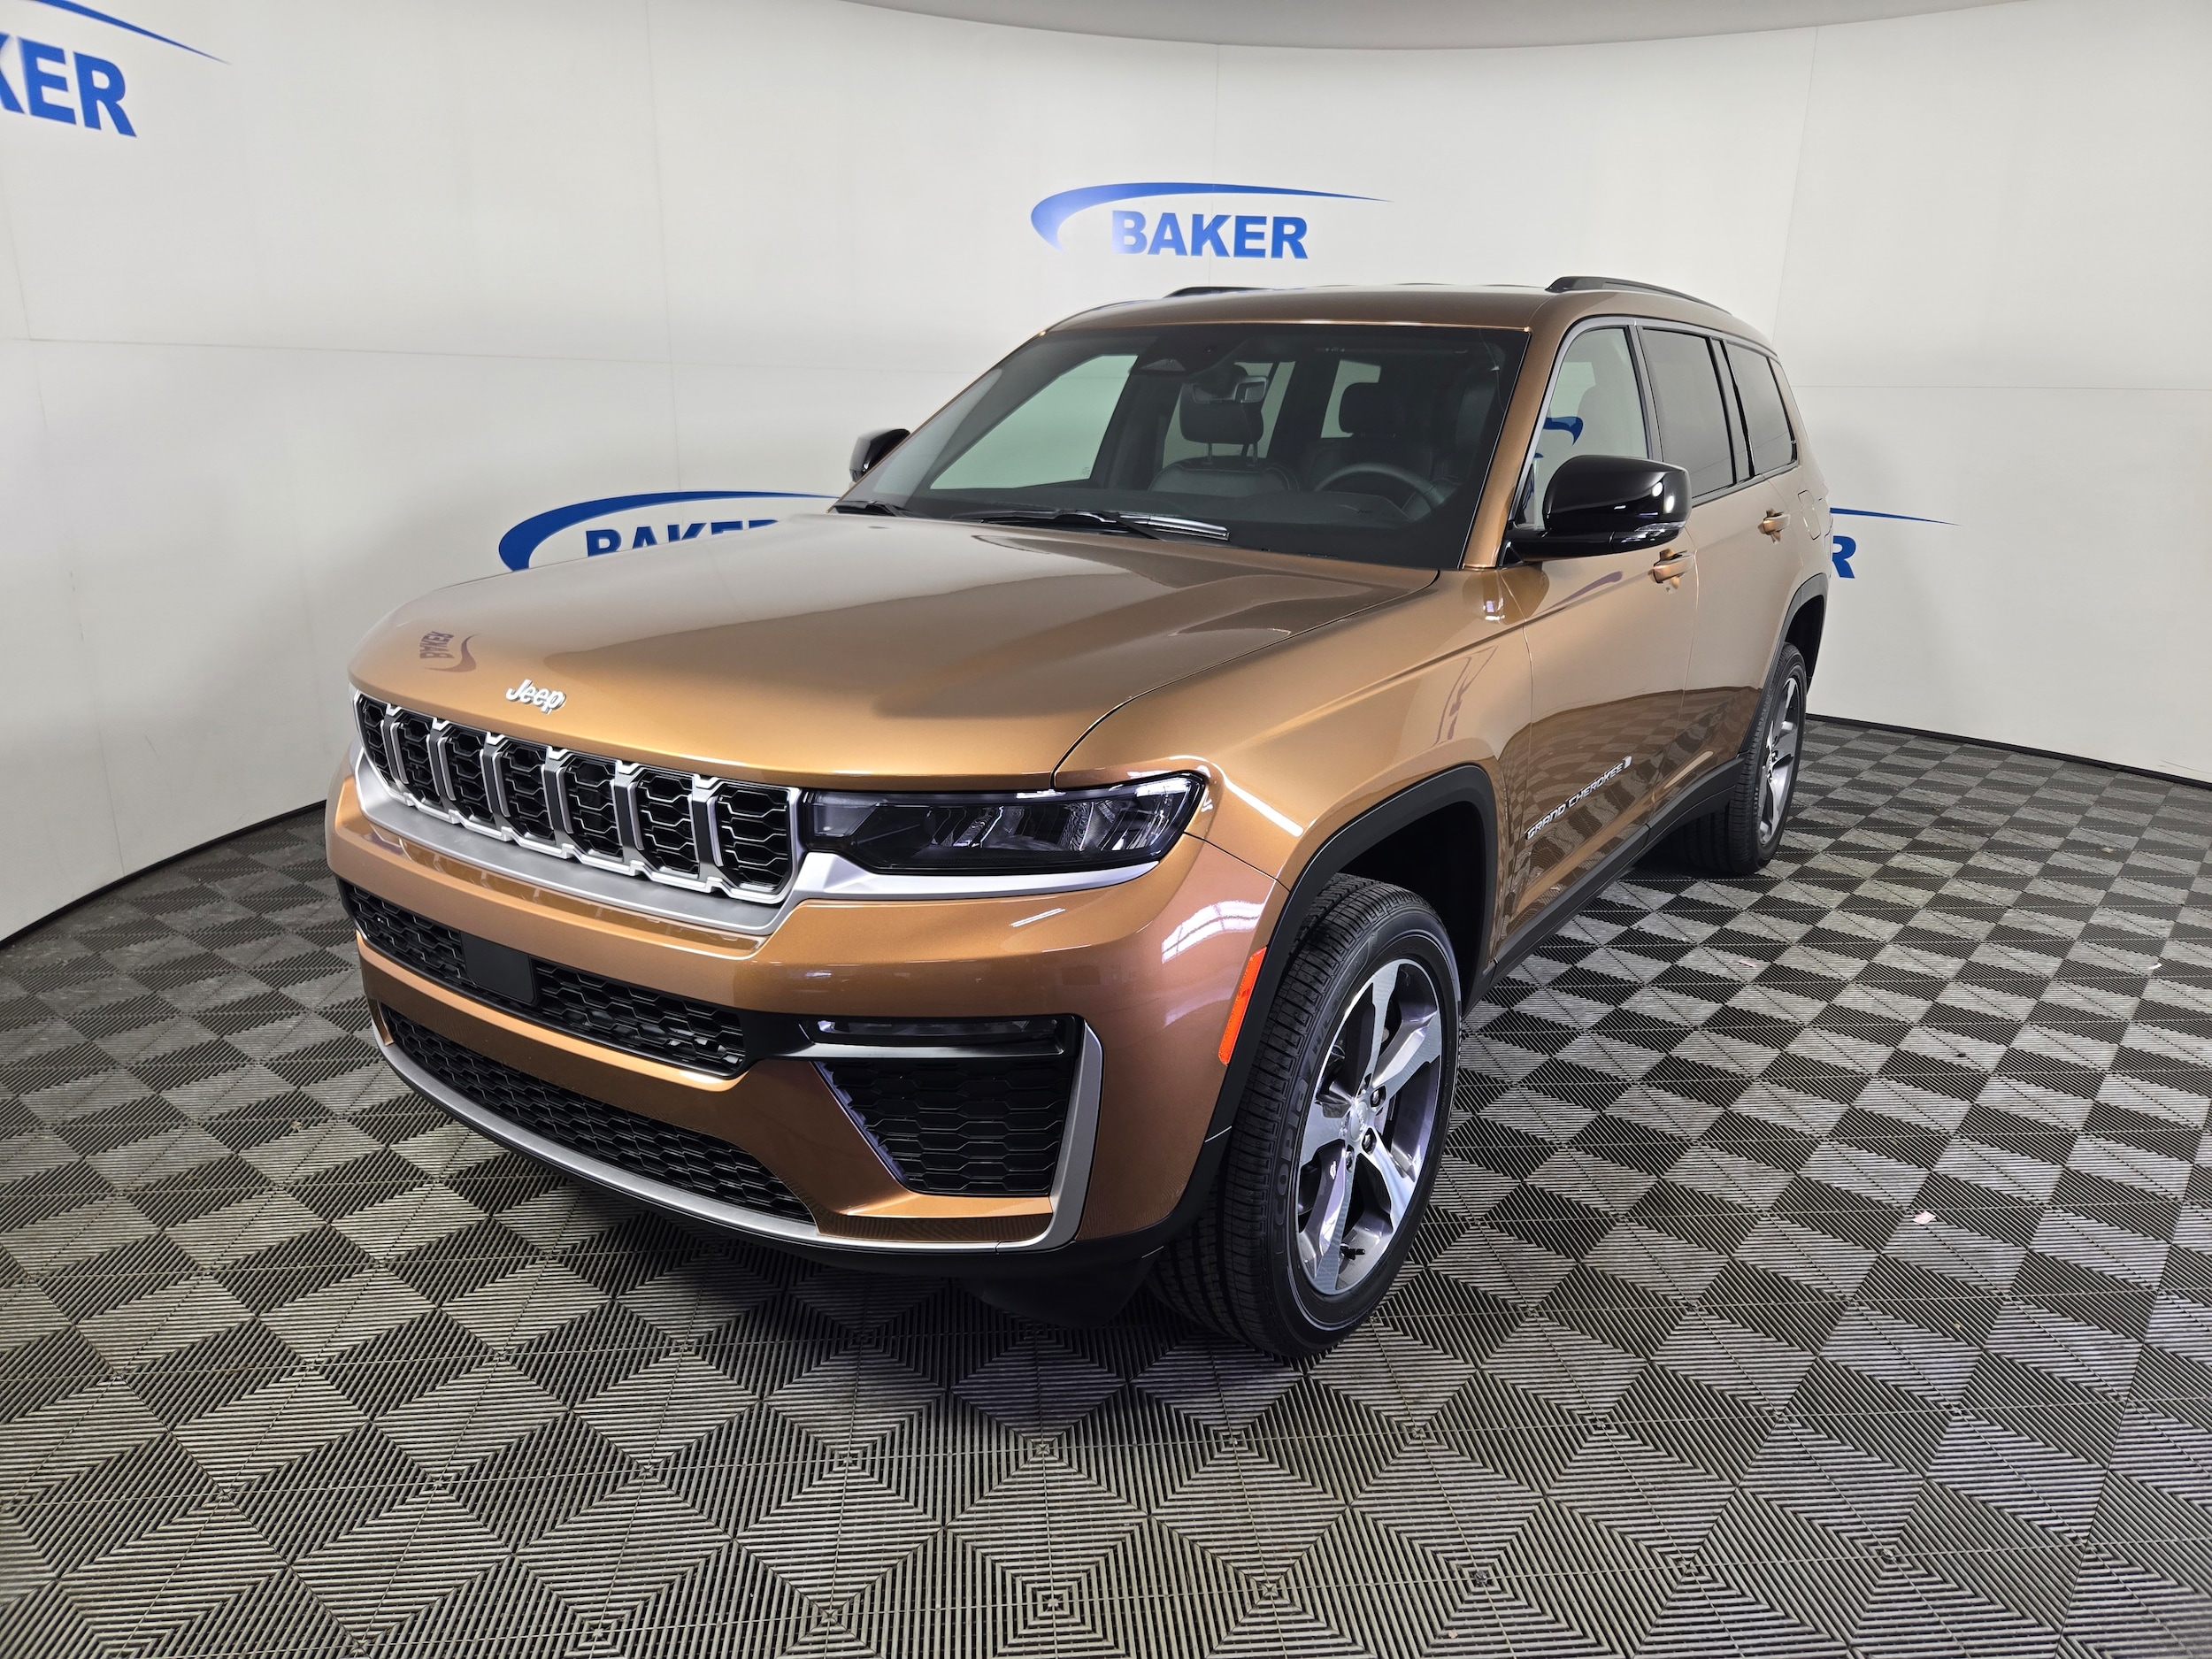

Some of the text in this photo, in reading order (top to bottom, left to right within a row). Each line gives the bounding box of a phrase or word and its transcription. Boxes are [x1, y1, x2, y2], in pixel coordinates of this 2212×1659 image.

[1111, 210, 1310, 259] BAKER
[505, 679, 567, 715] Jeep
[1525, 762, 1624, 840] GRAND CHEROKEE
